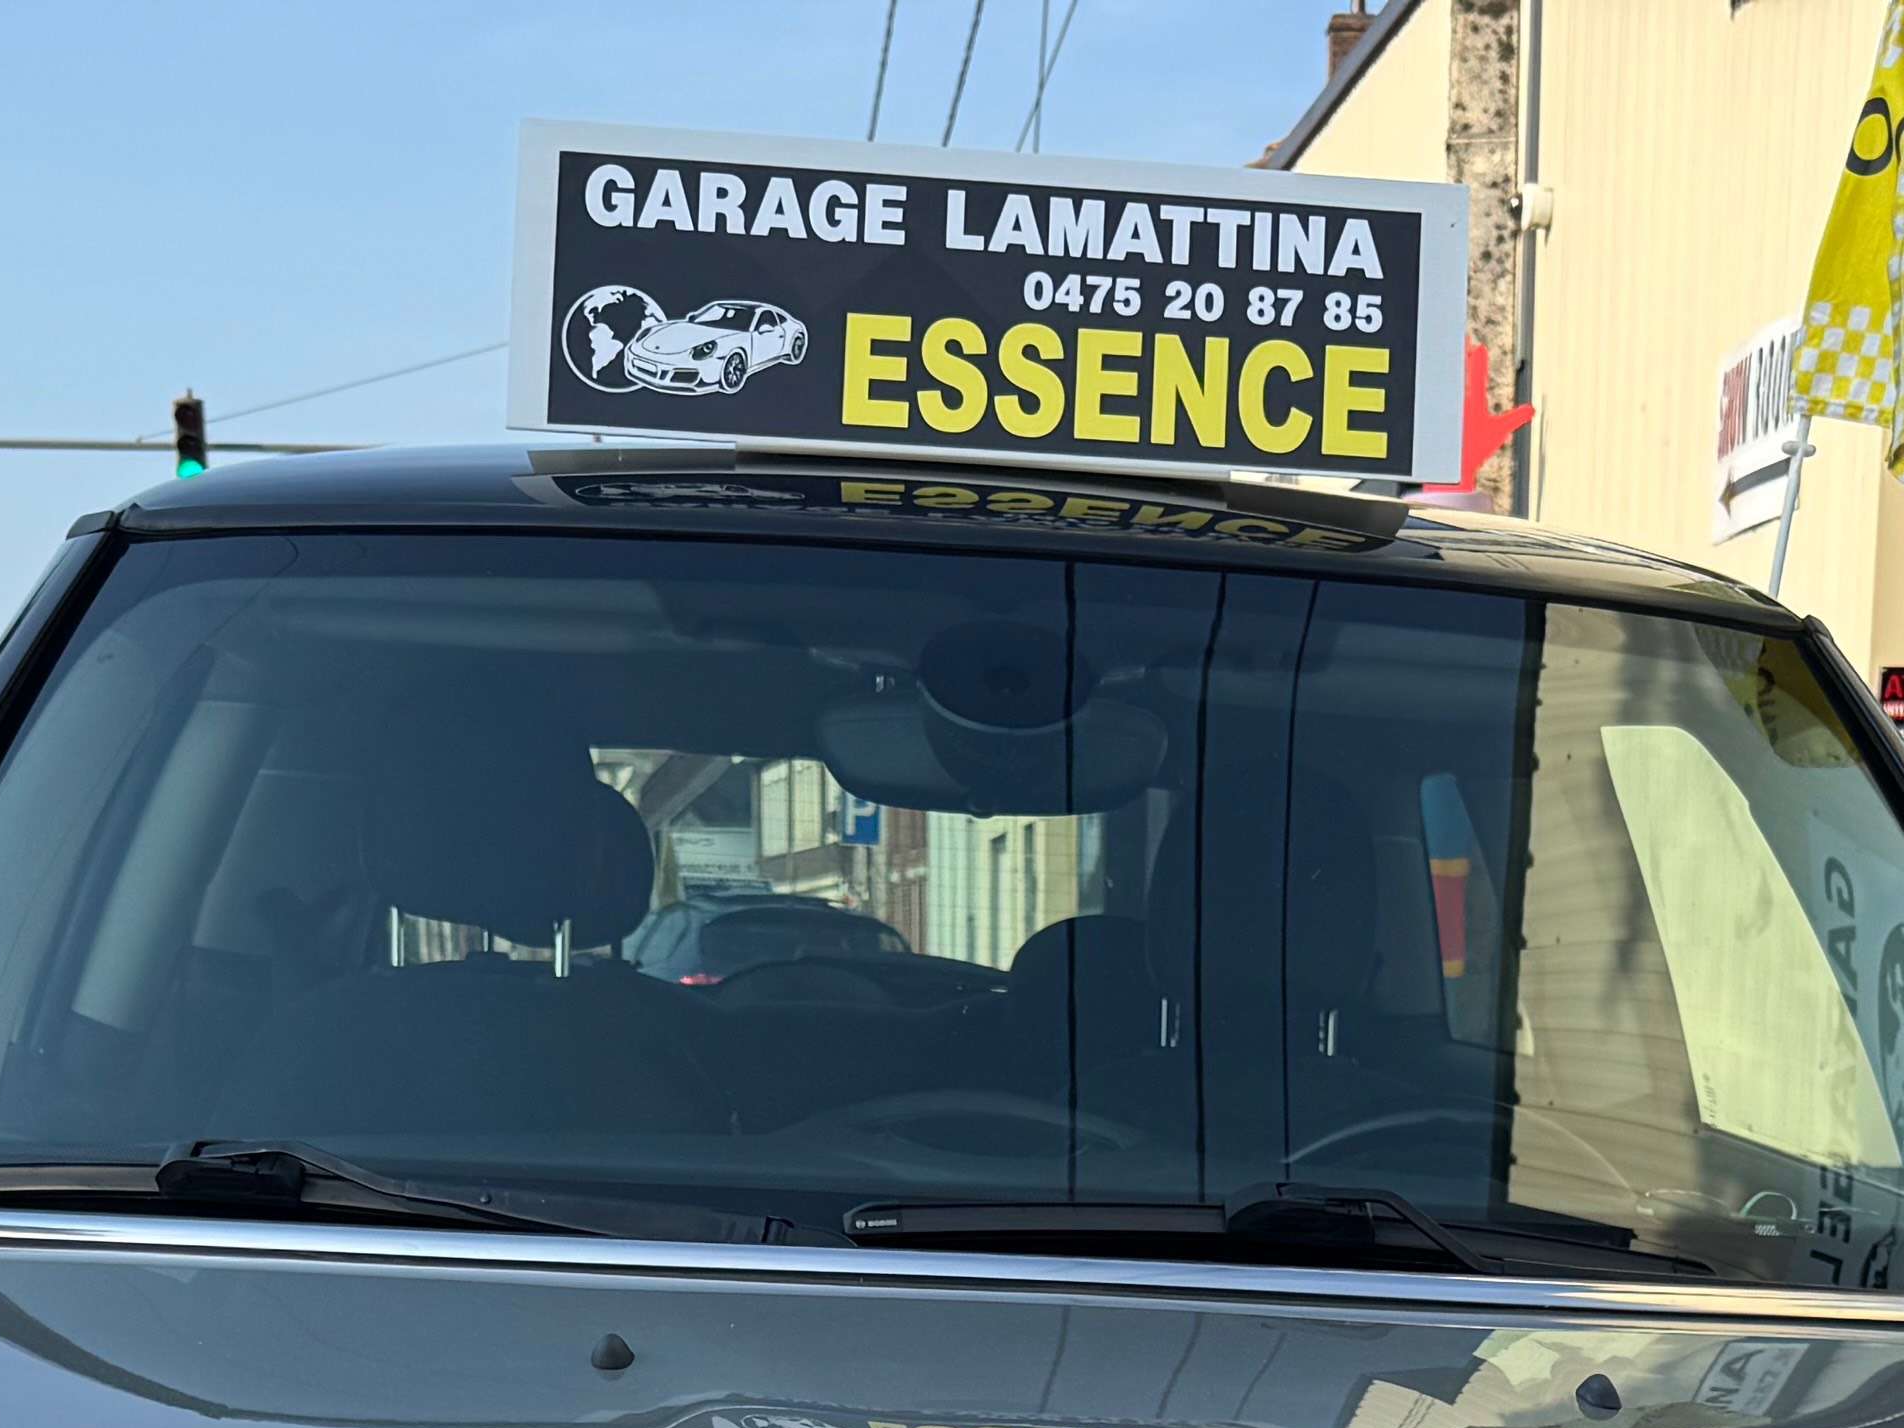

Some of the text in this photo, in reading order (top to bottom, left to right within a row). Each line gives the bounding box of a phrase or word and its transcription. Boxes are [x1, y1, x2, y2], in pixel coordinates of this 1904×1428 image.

[584, 163, 1384, 279] GARAGE LAMATTINA
[1023, 271, 1383, 333] 0475 20 87 85
[842, 313, 1390, 459] ESSENCE
[845, 796, 879, 836] P
